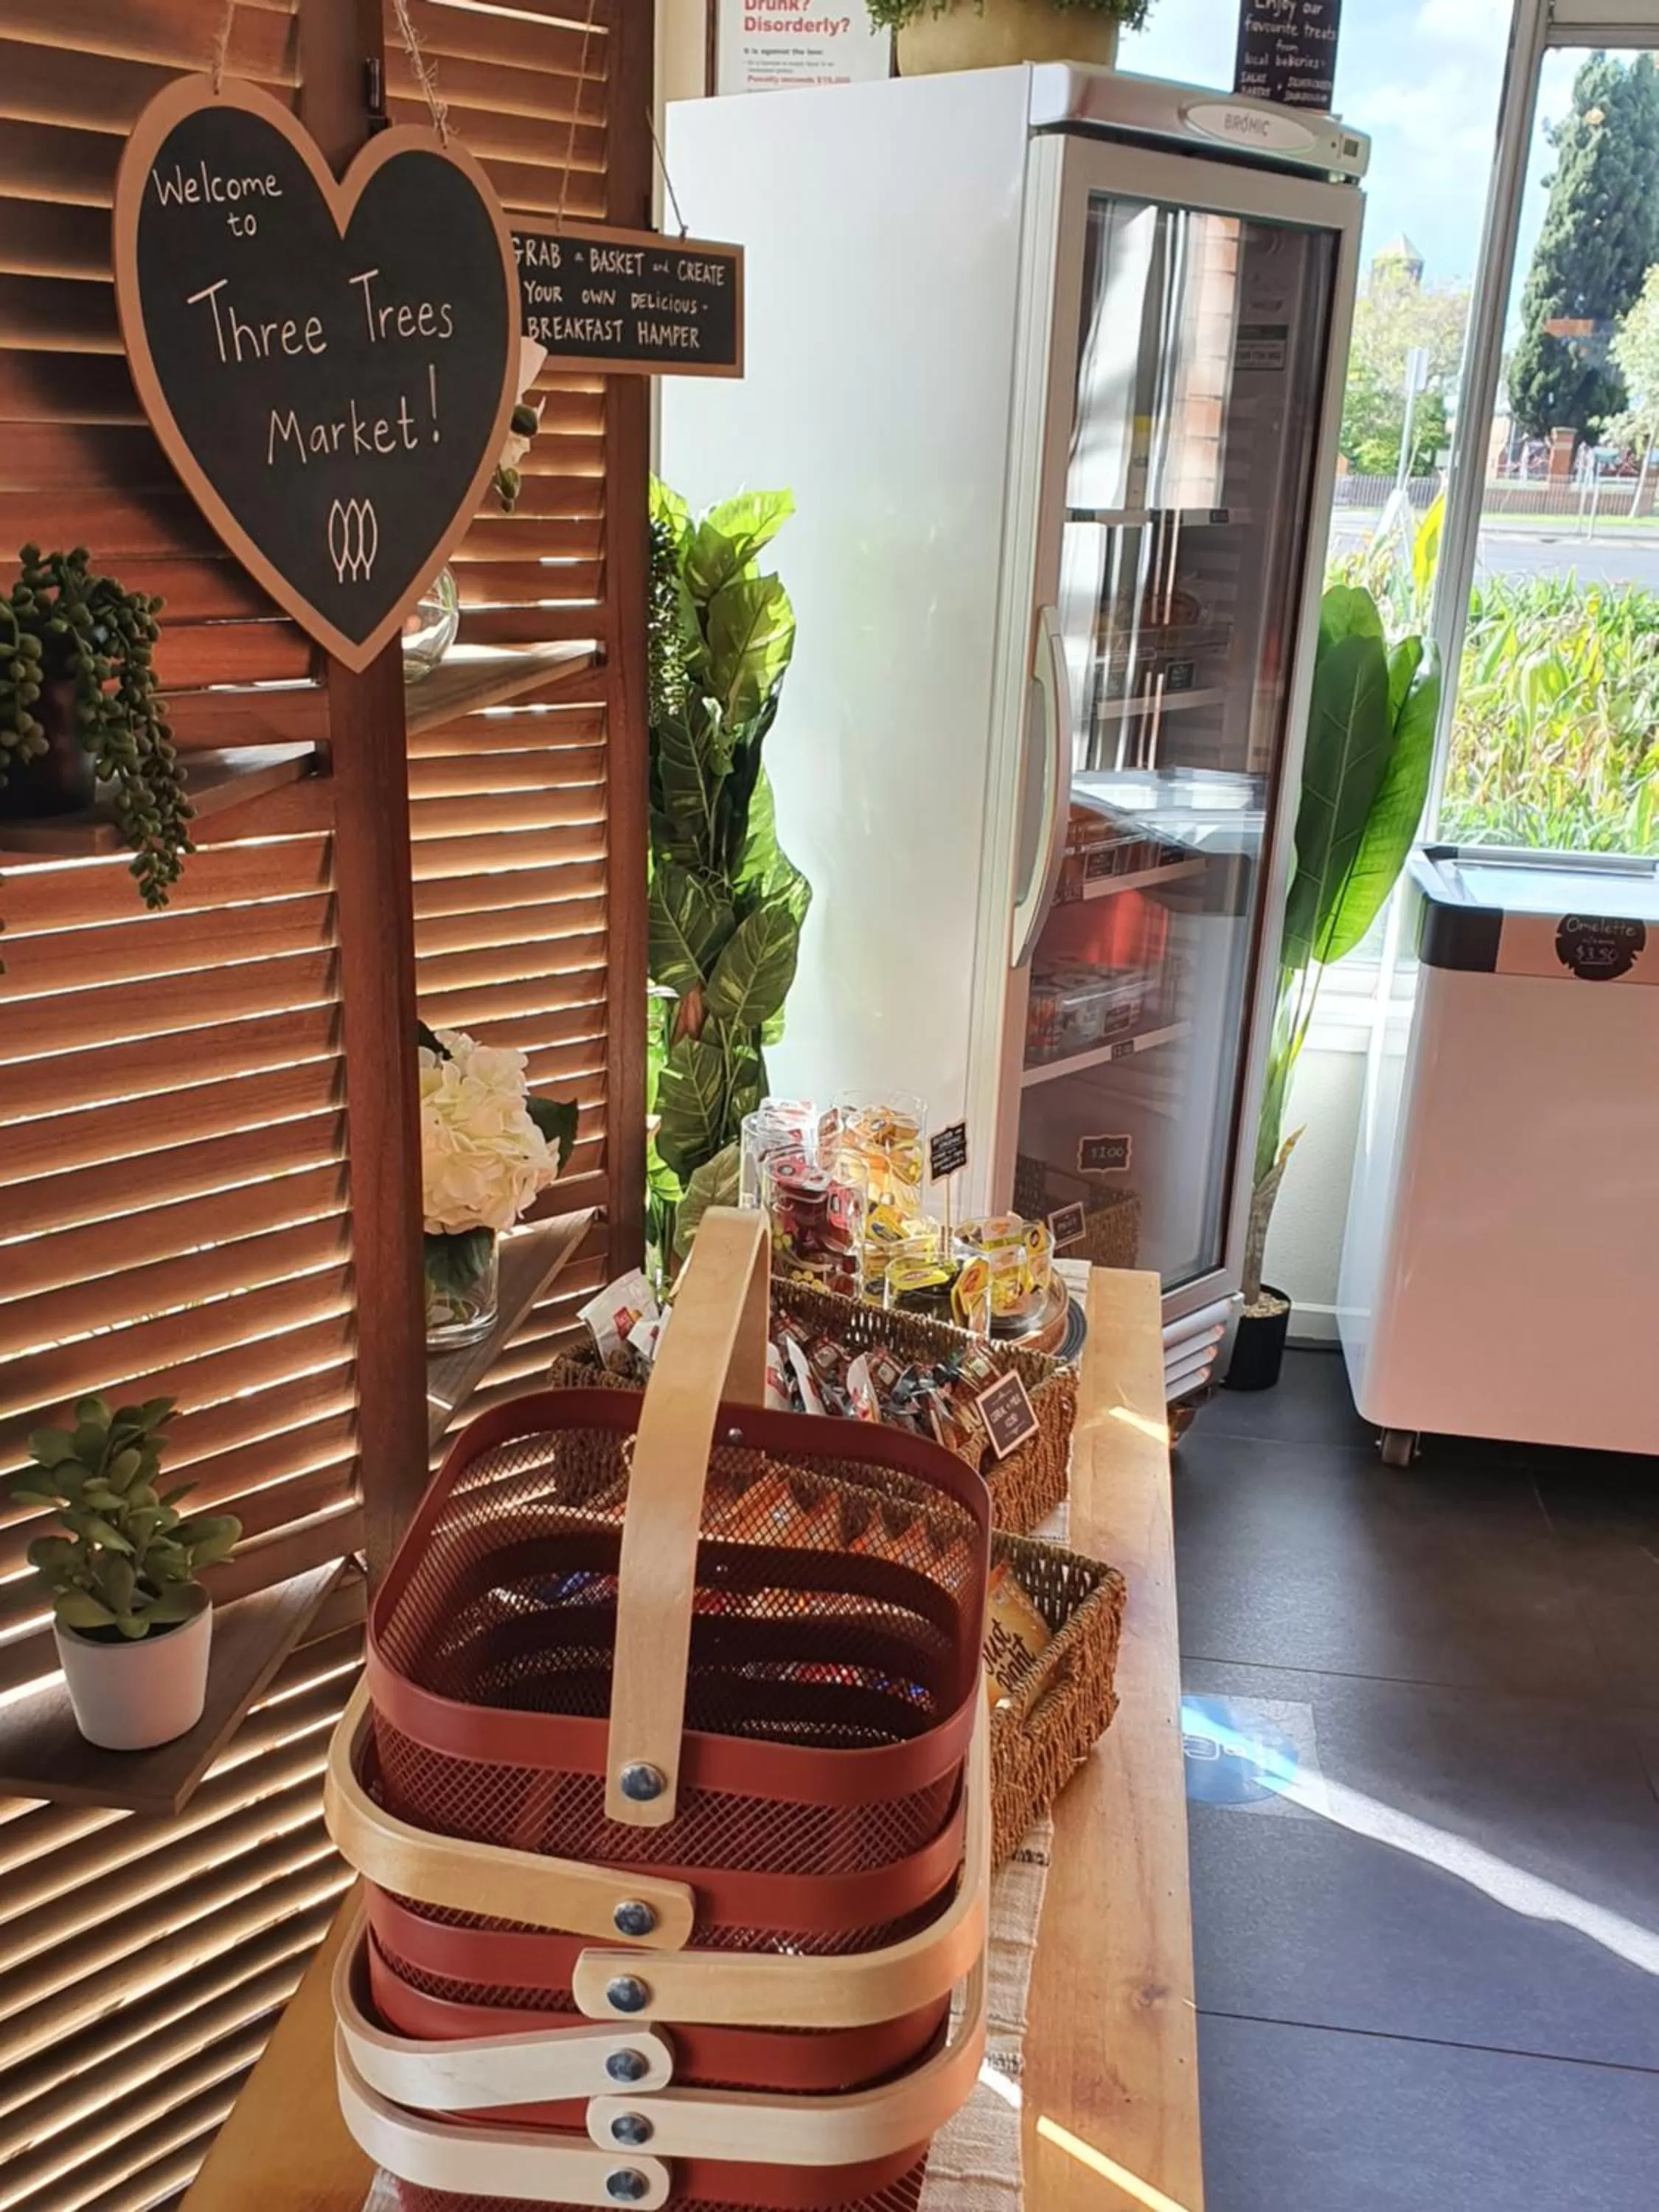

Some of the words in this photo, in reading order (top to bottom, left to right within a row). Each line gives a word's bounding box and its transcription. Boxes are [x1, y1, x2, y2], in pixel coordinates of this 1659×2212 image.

[744, 15, 850, 36] Disorderly?
[152, 160, 282, 206] Welcome
[227, 212, 257, 236] to
[511, 236, 562, 269] GRAB
[590, 248, 645, 276] BASKET
[653, 260, 669, 273] and
[677, 260, 726, 286] CREATE
[524, 279, 563, 305] YOUR
[581, 288, 616, 305] OWN
[187, 279, 327, 363] Three
[349, 269, 453, 343] Trees
[527, 316, 624, 342] BREAKFAST
[637, 321, 700, 349] HAMPER
[266, 364, 441, 466] Market!
